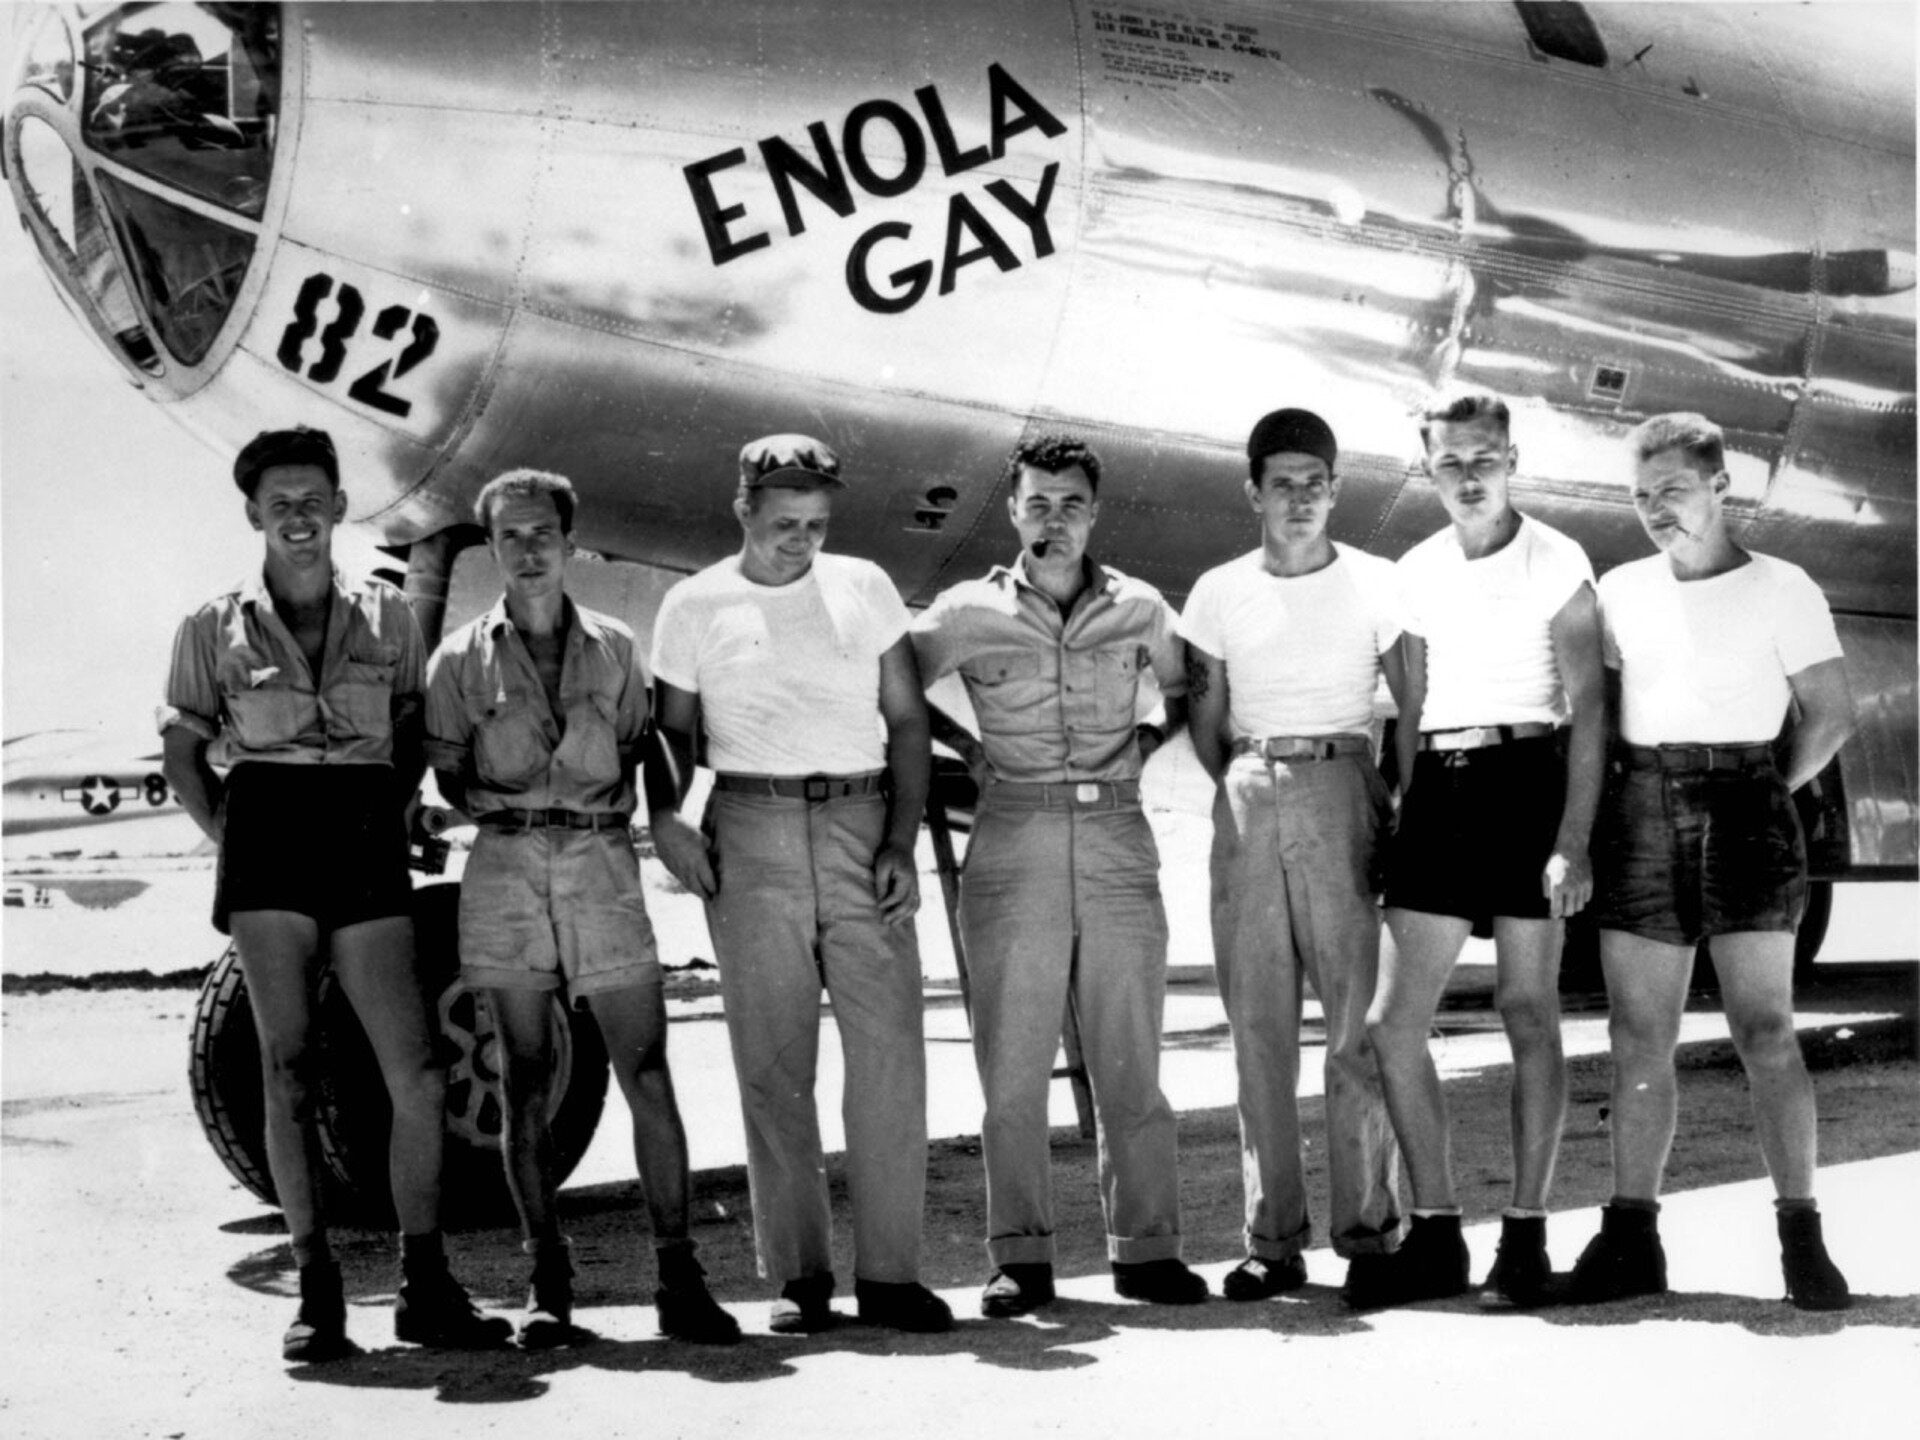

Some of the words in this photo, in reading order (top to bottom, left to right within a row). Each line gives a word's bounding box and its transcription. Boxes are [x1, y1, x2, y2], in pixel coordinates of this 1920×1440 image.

[682, 61, 1068, 267] ENOLA
[845, 161, 1060, 314] GAY
[276, 272, 440, 418] 82
[144, 772, 182, 807] 8
